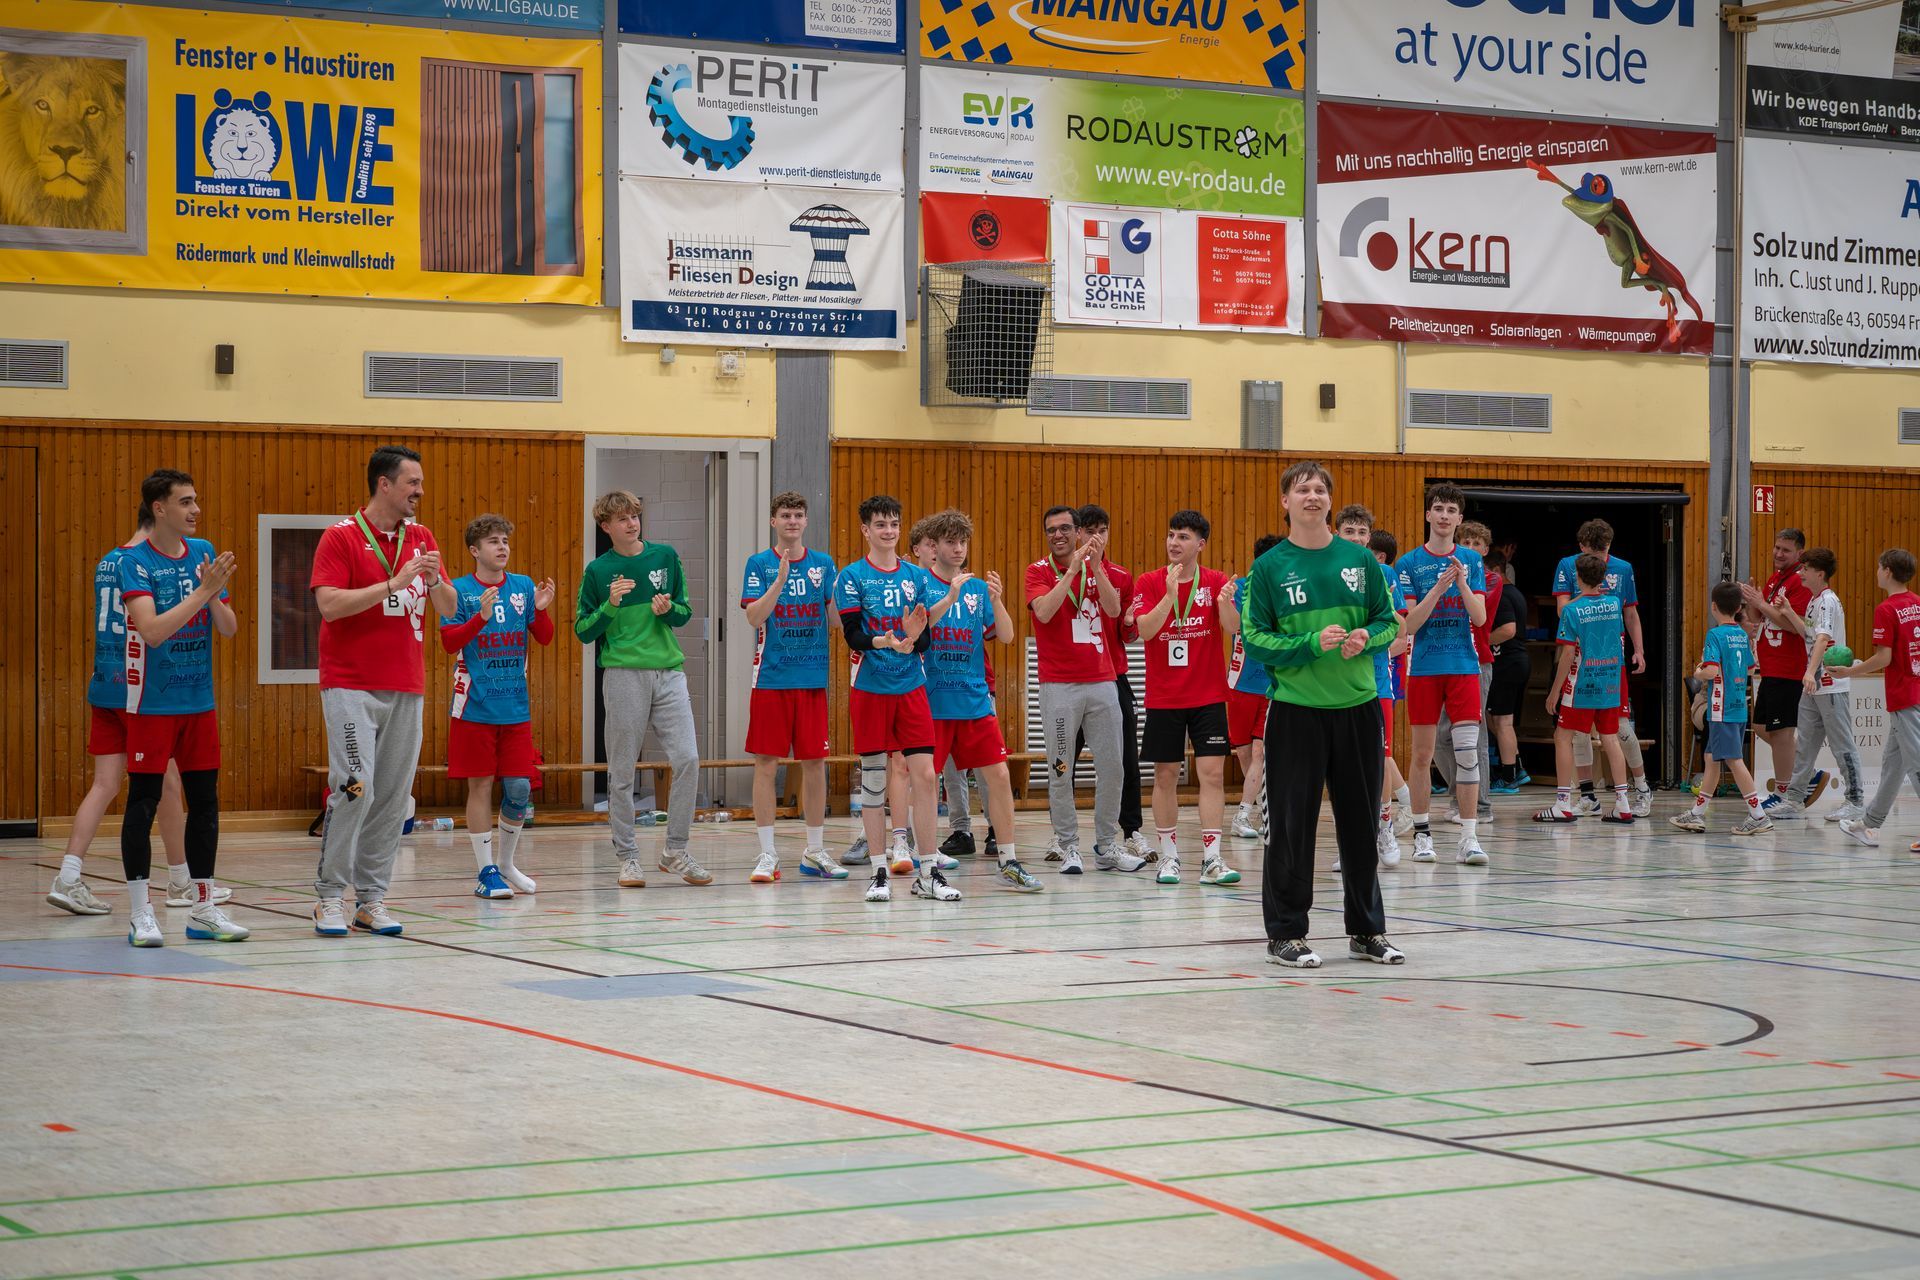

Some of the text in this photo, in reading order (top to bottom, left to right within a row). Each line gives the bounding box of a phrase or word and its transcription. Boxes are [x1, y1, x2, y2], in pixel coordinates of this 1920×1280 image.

[443, 0, 579, 19] WWW.LIGBAU.DE
[810, 1, 822, 11] TEL
[832, 3, 856, 13] 06106
[863, 6, 892, 16] 771465
[810, 12, 892, 27] FAX 06106 72980
[1180, 33, 1220, 47] Energie
[1774, 41, 1840, 55] www.kde-kurier.de
[175, 38, 394, 81] Fenster Haustüren
[1395, 22, 1647, 84] at your side
[697, 97, 818, 117] Montagedienstleistungen
[1752, 88, 1780, 107] Wir
[1785, 92, 1859, 117] bewegen
[1799, 116, 1818, 127] KDE
[1820, 118, 1860, 132] Transport
[1862, 122, 1888, 134] GmbH
[1010, 133, 1034, 141] RODAU
[356, 113, 376, 198] Qualität seit 1898
[940, 153, 1022, 166] Gemeinschaftsunternehmen
[1335, 137, 1608, 172] Mit uns nachhaltig Energie einsparen
[759, 166, 881, 182] www.perit-dienstleistung.de
[929, 165, 980, 176] STADTWERKE
[991, 169, 1033, 180] MAINGAU
[1620, 159, 1698, 176] www.kern-ewt.de
[195, 181, 280, 197] Fenster & Türen
[1096, 164, 1286, 196] www.ev-rodau.de
[176, 199, 394, 227] Direkt vom Hersteller
[1213, 228, 1271, 241] Gotta Söhne
[667, 239, 753, 261] Jassmann
[1213, 247, 1260, 255] Max-Planck-Straße
[1409, 218, 1510, 273] kern
[1753, 231, 1798, 258] Solz
[1801, 236, 1838, 262] und
[176, 243, 395, 270] Rödermark und Kleinwallstadt
[668, 263, 799, 291] Fliesen Design
[1085, 275, 1145, 289] GOTTA
[1412, 270, 1506, 285] Energie- und Wassertechnik
[1754, 267, 1784, 288] Inh.
[1835, 273, 1863, 293] und
[1866, 276, 1877, 294] J.
[1881, 276, 1920, 301] Rupp
[668, 288, 863, 305] Meisterbetrieb der Fliesen-, Platten- und Mosaikleger
[1085, 287, 1145, 303] SÖHNE
[668, 305, 680, 314] 63
[687, 306, 707, 316] 110
[713, 307, 756, 319] Rodgau
[770, 309, 825, 321] Dresdner
[1214, 302, 1274, 310] www.gotta-bau.de
[685, 317, 711, 329] Tel.
[722, 319, 729, 329] 0
[735, 320, 750, 330] 61
[758, 320, 772, 330] 06
[789, 321, 804, 332] 70
[812, 322, 826, 332] 74
[833, 323, 846, 333] 42
[1754, 306, 1843, 326] Brückenstraße
[1846, 312, 1864, 330] 43,
[1867, 312, 1906, 330] 60594
[1389, 317, 1656, 344] Pelletheizungen Solaranlagen Wärmepumpen
[1754, 335, 1920, 361] www.solzundzimm
[179, 579, 193, 602] 13
[788, 578, 806, 597] 30
[1286, 585, 1307, 605] 16
[388, 594, 400, 608] B
[883, 589, 901, 608] 21
[1435, 595, 1464, 611] EWE
[494, 605, 506, 623] 8
[774, 603, 821, 619] REWE
[1576, 600, 1619, 617] handball
[868, 616, 904, 632] REW
[477, 631, 524, 649] REWE
[931, 627, 973, 645] REWE
[1173, 646, 1184, 660] C
[1856, 697, 1882, 710] FÜR
[1056, 718, 1067, 756] SEHRING
[344, 722, 361, 773] SEHRING
